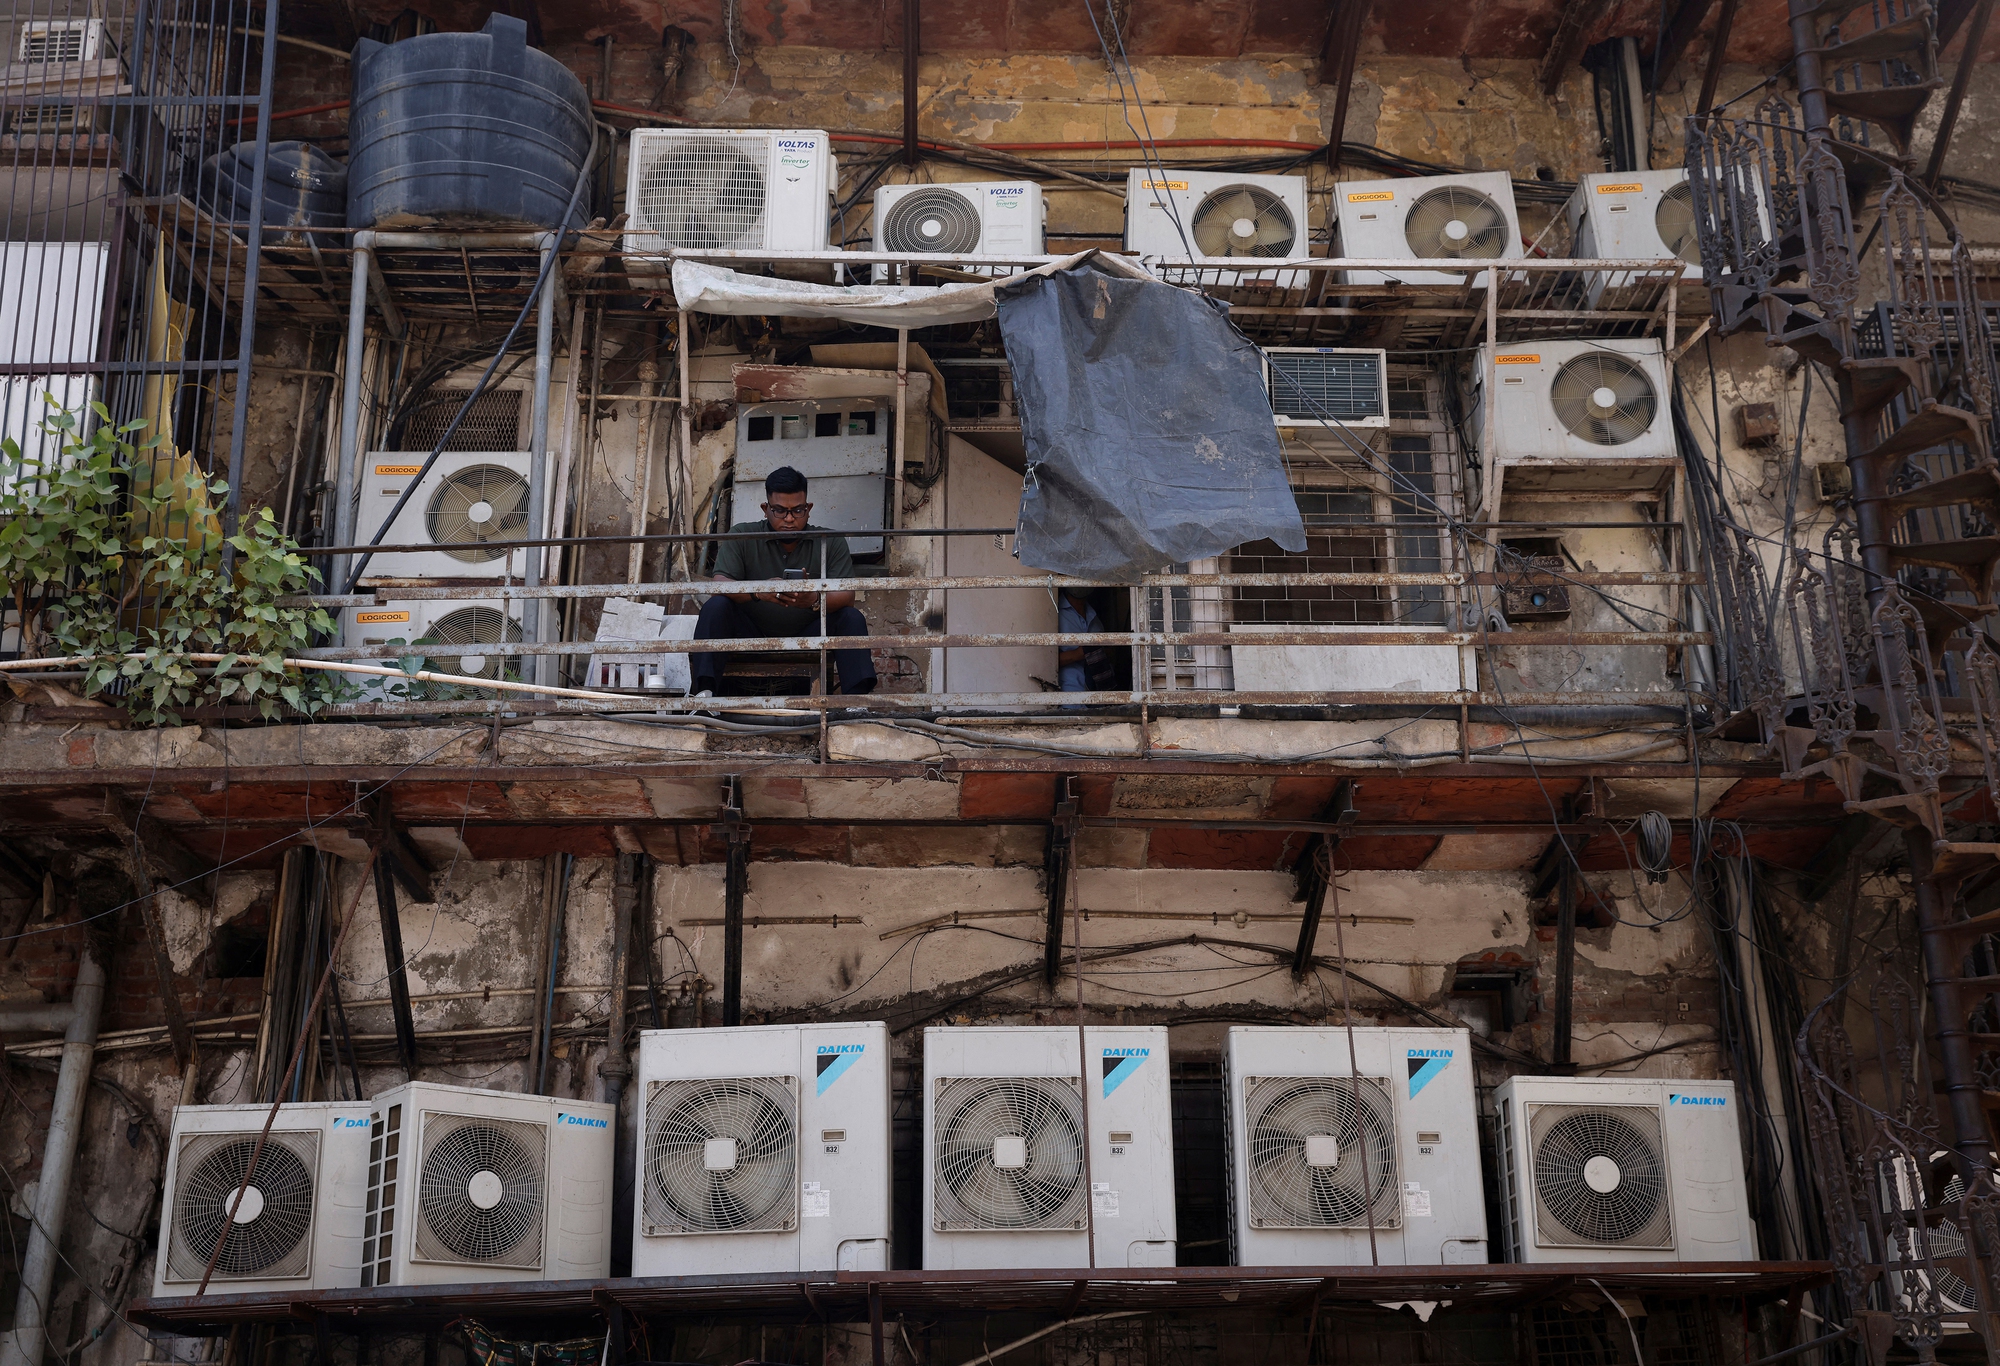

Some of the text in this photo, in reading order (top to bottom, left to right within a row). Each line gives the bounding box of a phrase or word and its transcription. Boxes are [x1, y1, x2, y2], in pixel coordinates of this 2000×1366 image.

[778, 140, 815, 148] VOLTAS
[817, 1044, 865, 1054] DAIKIN
[1102, 1048, 1150, 1056] DAIKIN
[1407, 1049, 1453, 1057] DAIKIN
[1681, 1096, 1726, 1106] DAIKIN
[345, 1119, 371, 1127] DAI
[567, 1116, 608, 1128] DAIKIN
